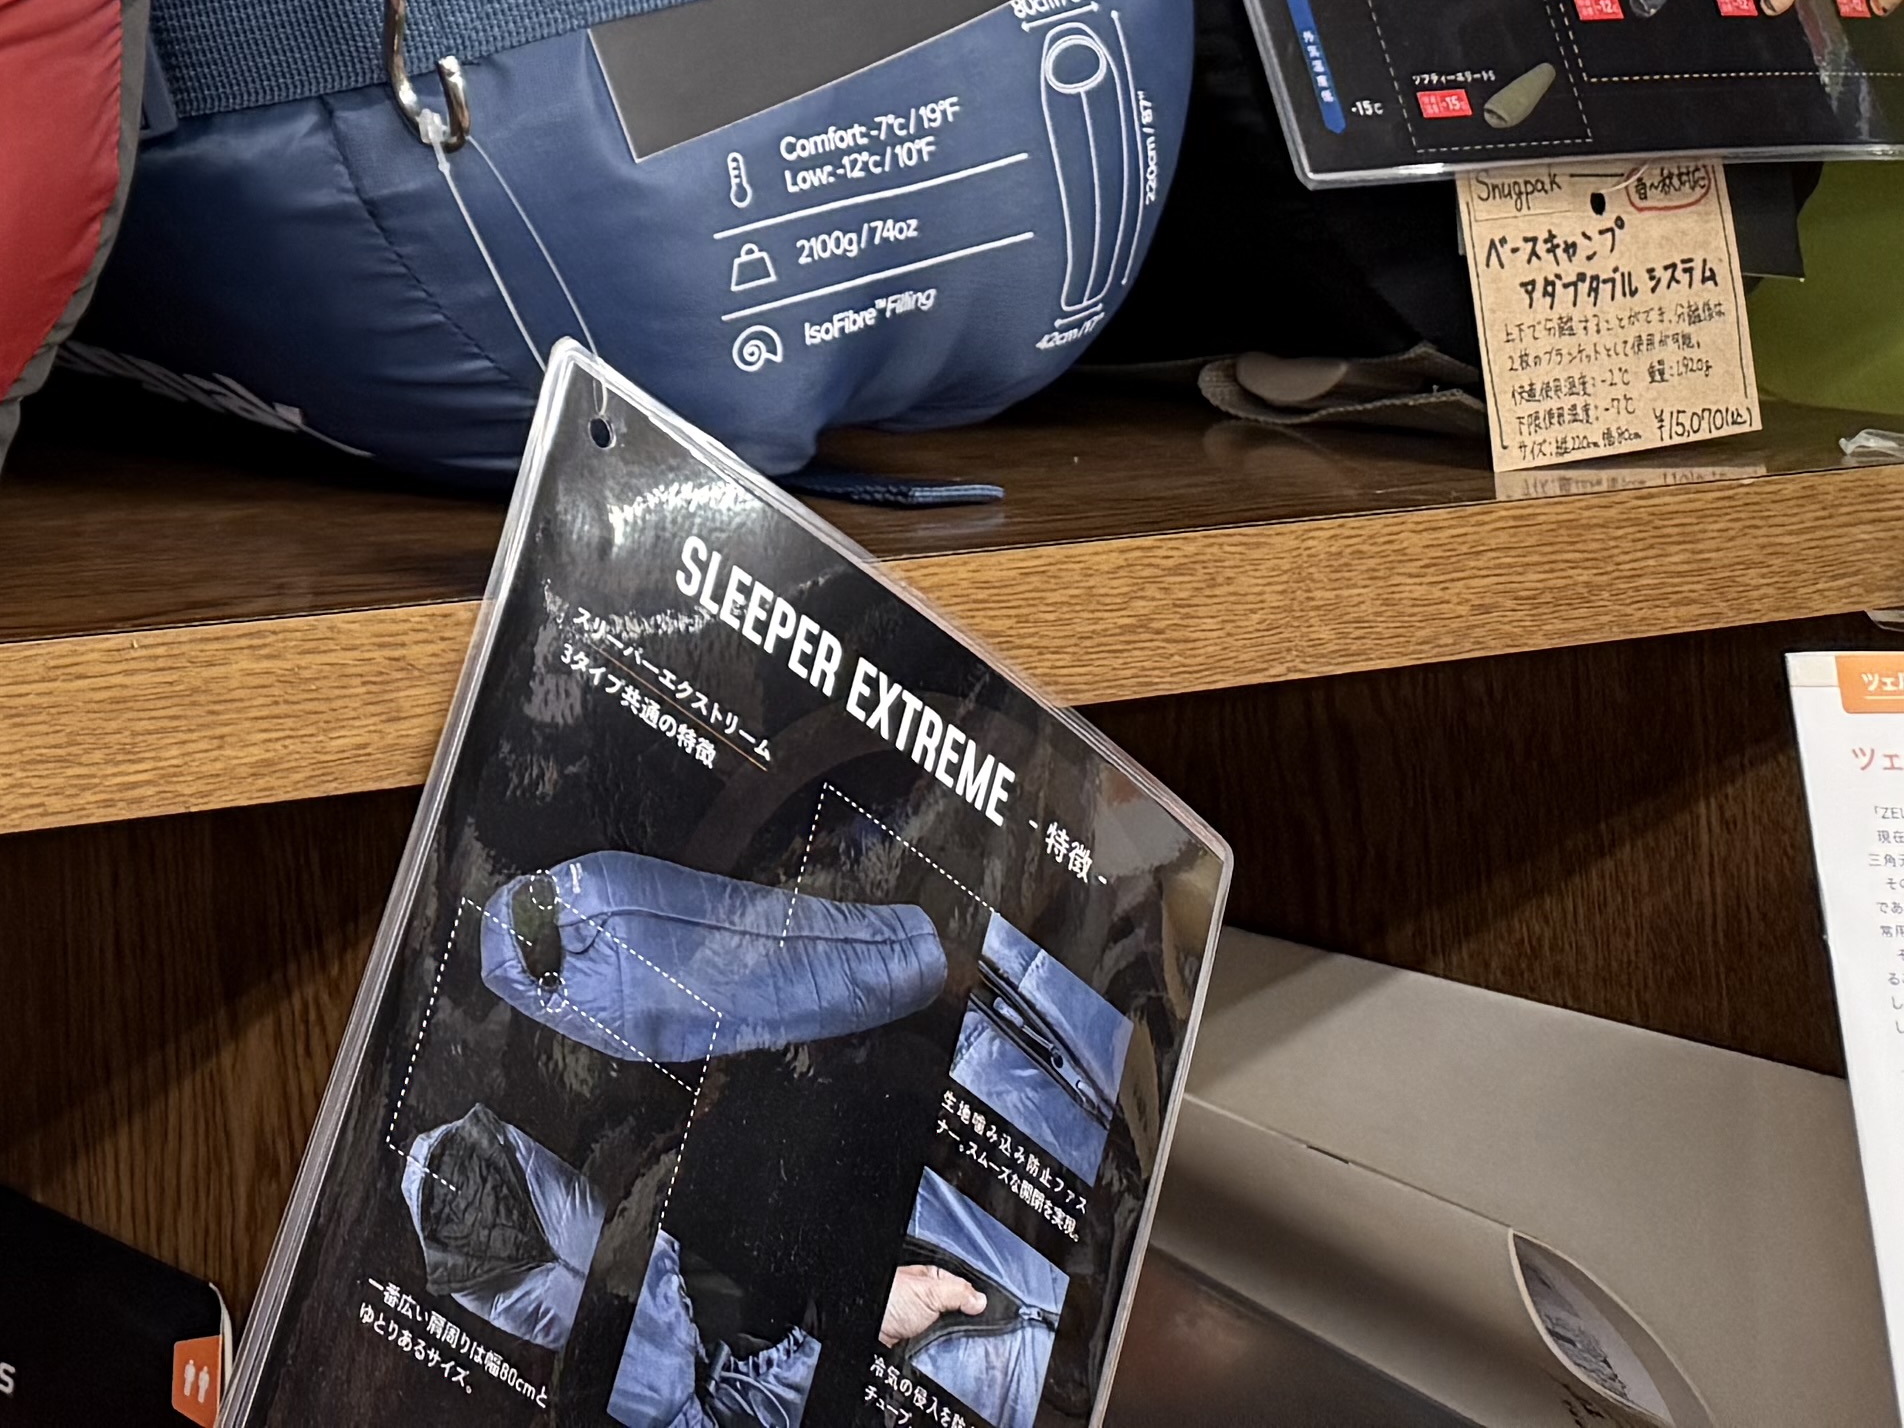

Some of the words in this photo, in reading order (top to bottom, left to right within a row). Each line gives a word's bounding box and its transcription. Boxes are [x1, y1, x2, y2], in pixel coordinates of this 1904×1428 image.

[1475, 171, 1562, 212] Snugpak
[1486, 216, 1625, 269] ベースキャンプ
[1647, 258, 1718, 293] システム
[885, 287, 936, 322] Filling
[561, 643, 717, 770] 3タイプ共通の特徴
[573, 606, 773, 762] スリーパーエクストリーム
[676, 535, 842, 698] SLEEPER
[845, 655, 1017, 826] EXTREME
[360, 1302, 472, 1394] ゆとりあるサイズ。
[368, 1278, 548, 1408] 一番広い肩周りは幅80cmと
